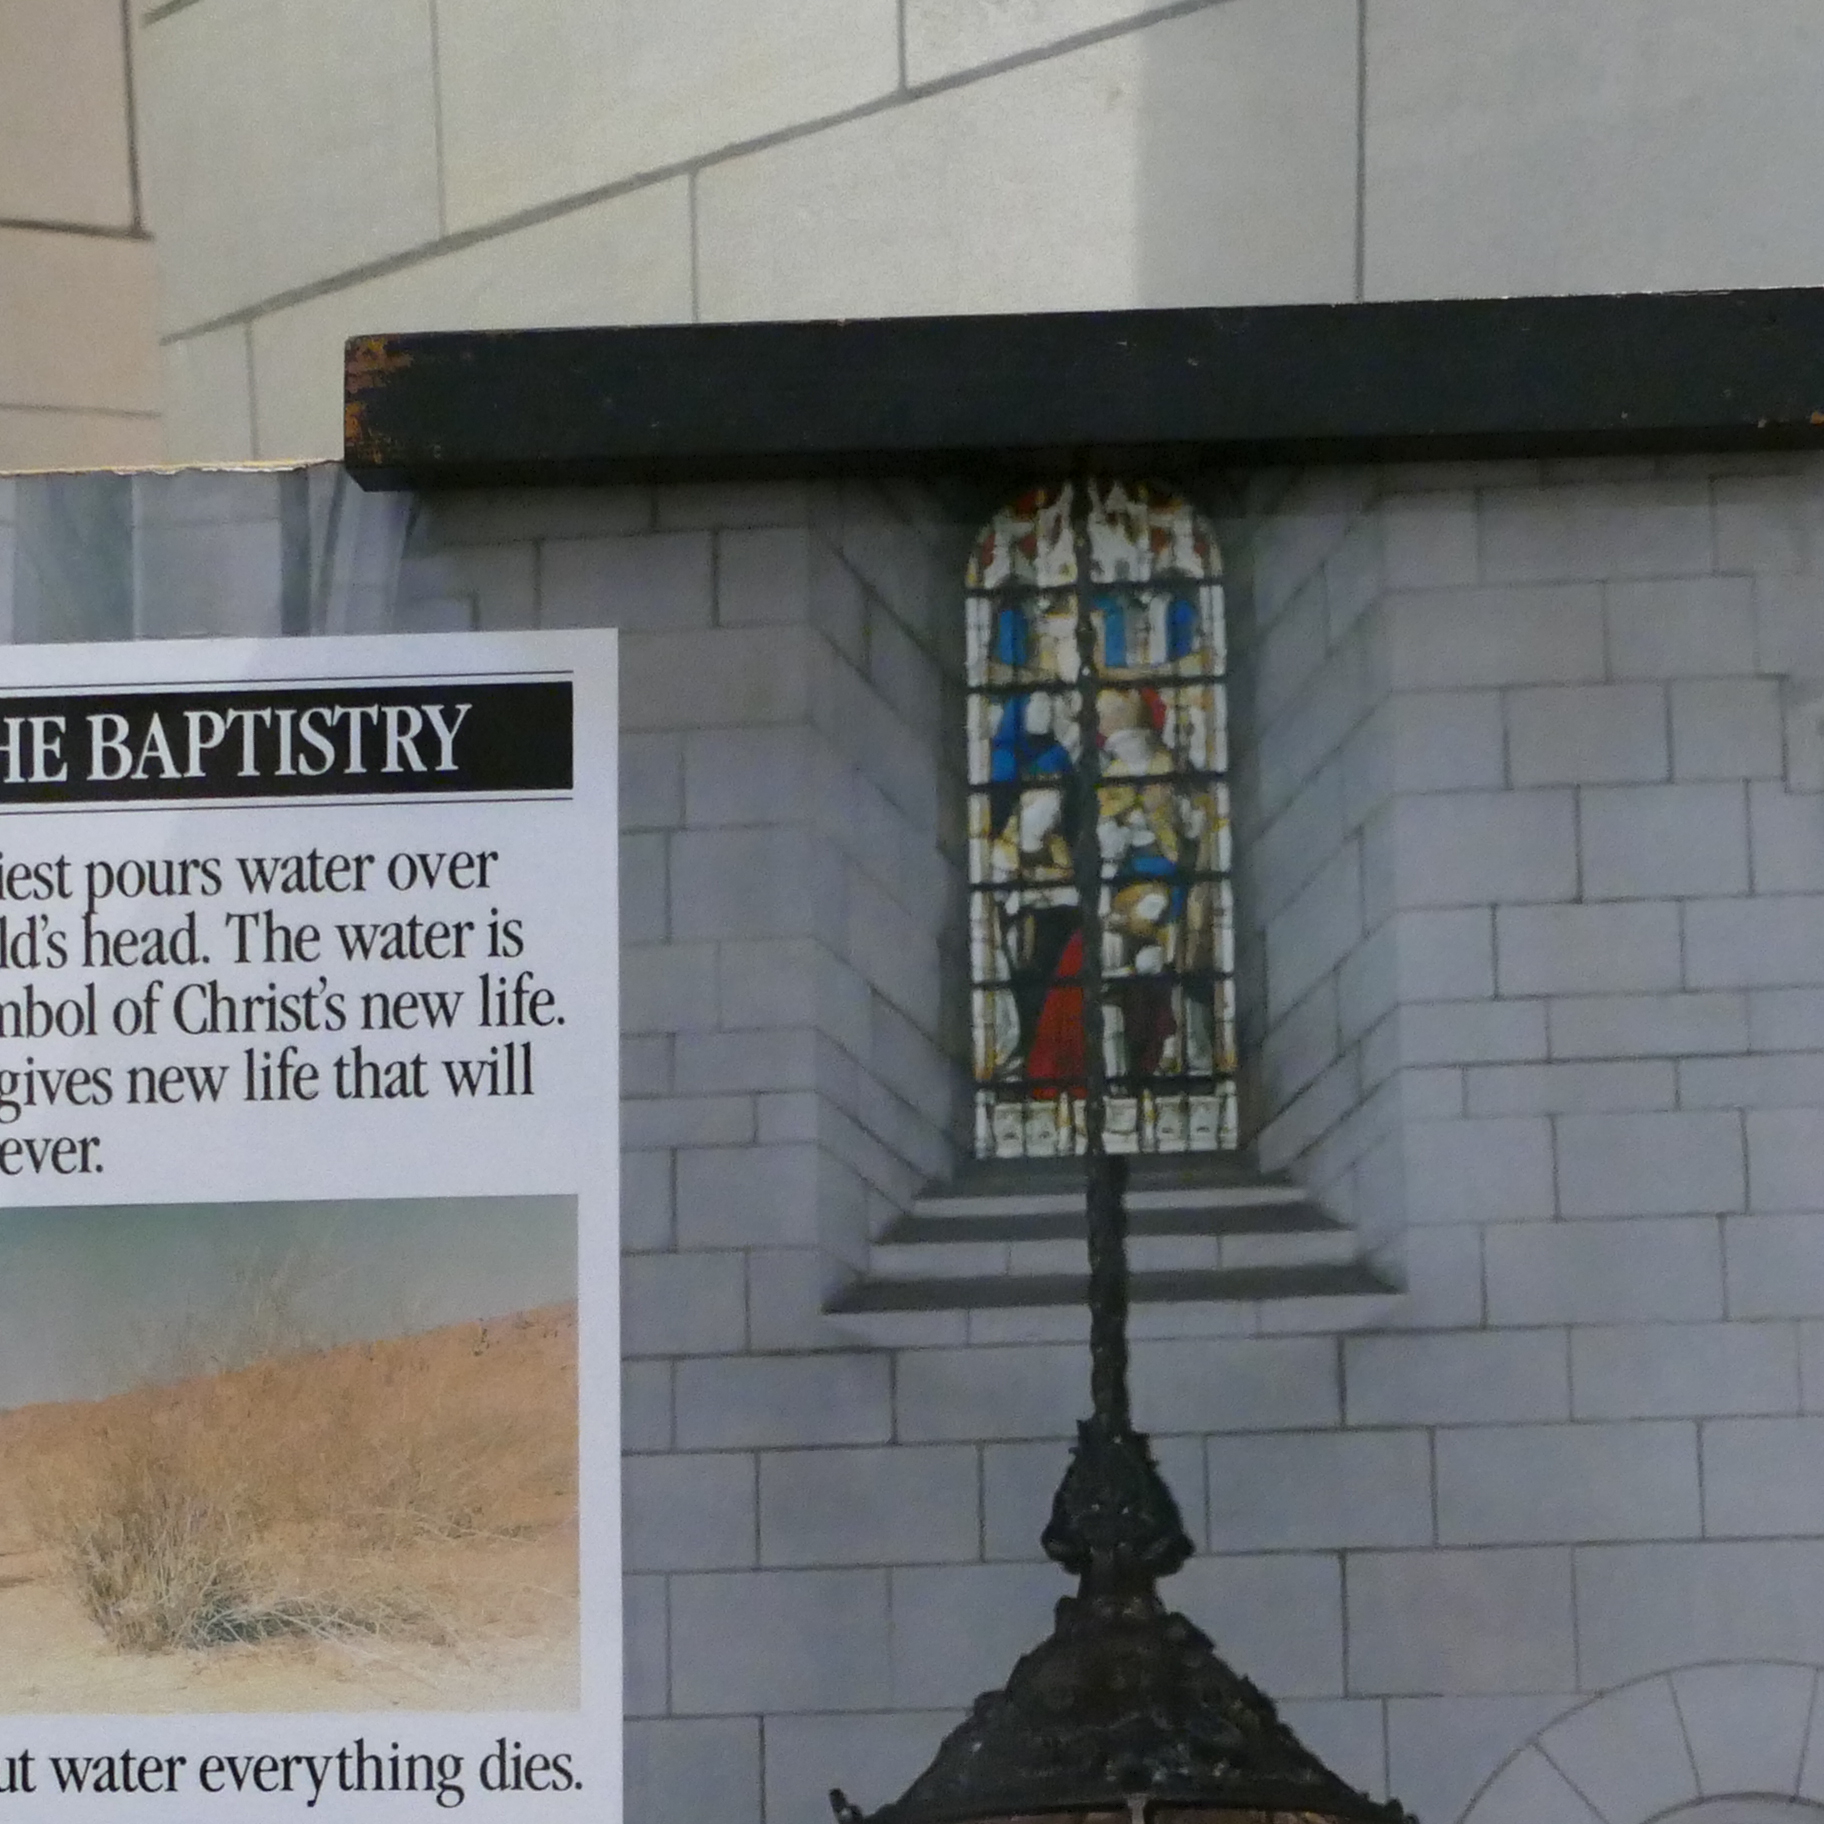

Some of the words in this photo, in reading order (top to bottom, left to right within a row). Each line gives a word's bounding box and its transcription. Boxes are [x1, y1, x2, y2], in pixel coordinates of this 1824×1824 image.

[86, 703, 473, 781] BAPTISTRY
[81, 857, 222, 916] pours
[236, 848, 376, 894] water
[387, 851, 499, 891] over
[81, 909, 210, 967] head.
[225, 908, 321, 964] The
[334, 914, 475, 961] water
[487, 907, 524, 958] is
[112, 979, 164, 1036] of
[361, 991, 464, 1030] new
[479, 970, 565, 1027] life.
[127, 1066, 230, 1104] new
[244, 1045, 320, 1101] life
[333, 1044, 429, 1100] that
[441, 1041, 534, 1097] will
[49, 1749, 187, 1793] water
[199, 1737, 465, 1809] everything
[479, 1737, 583, 1792] dies.
